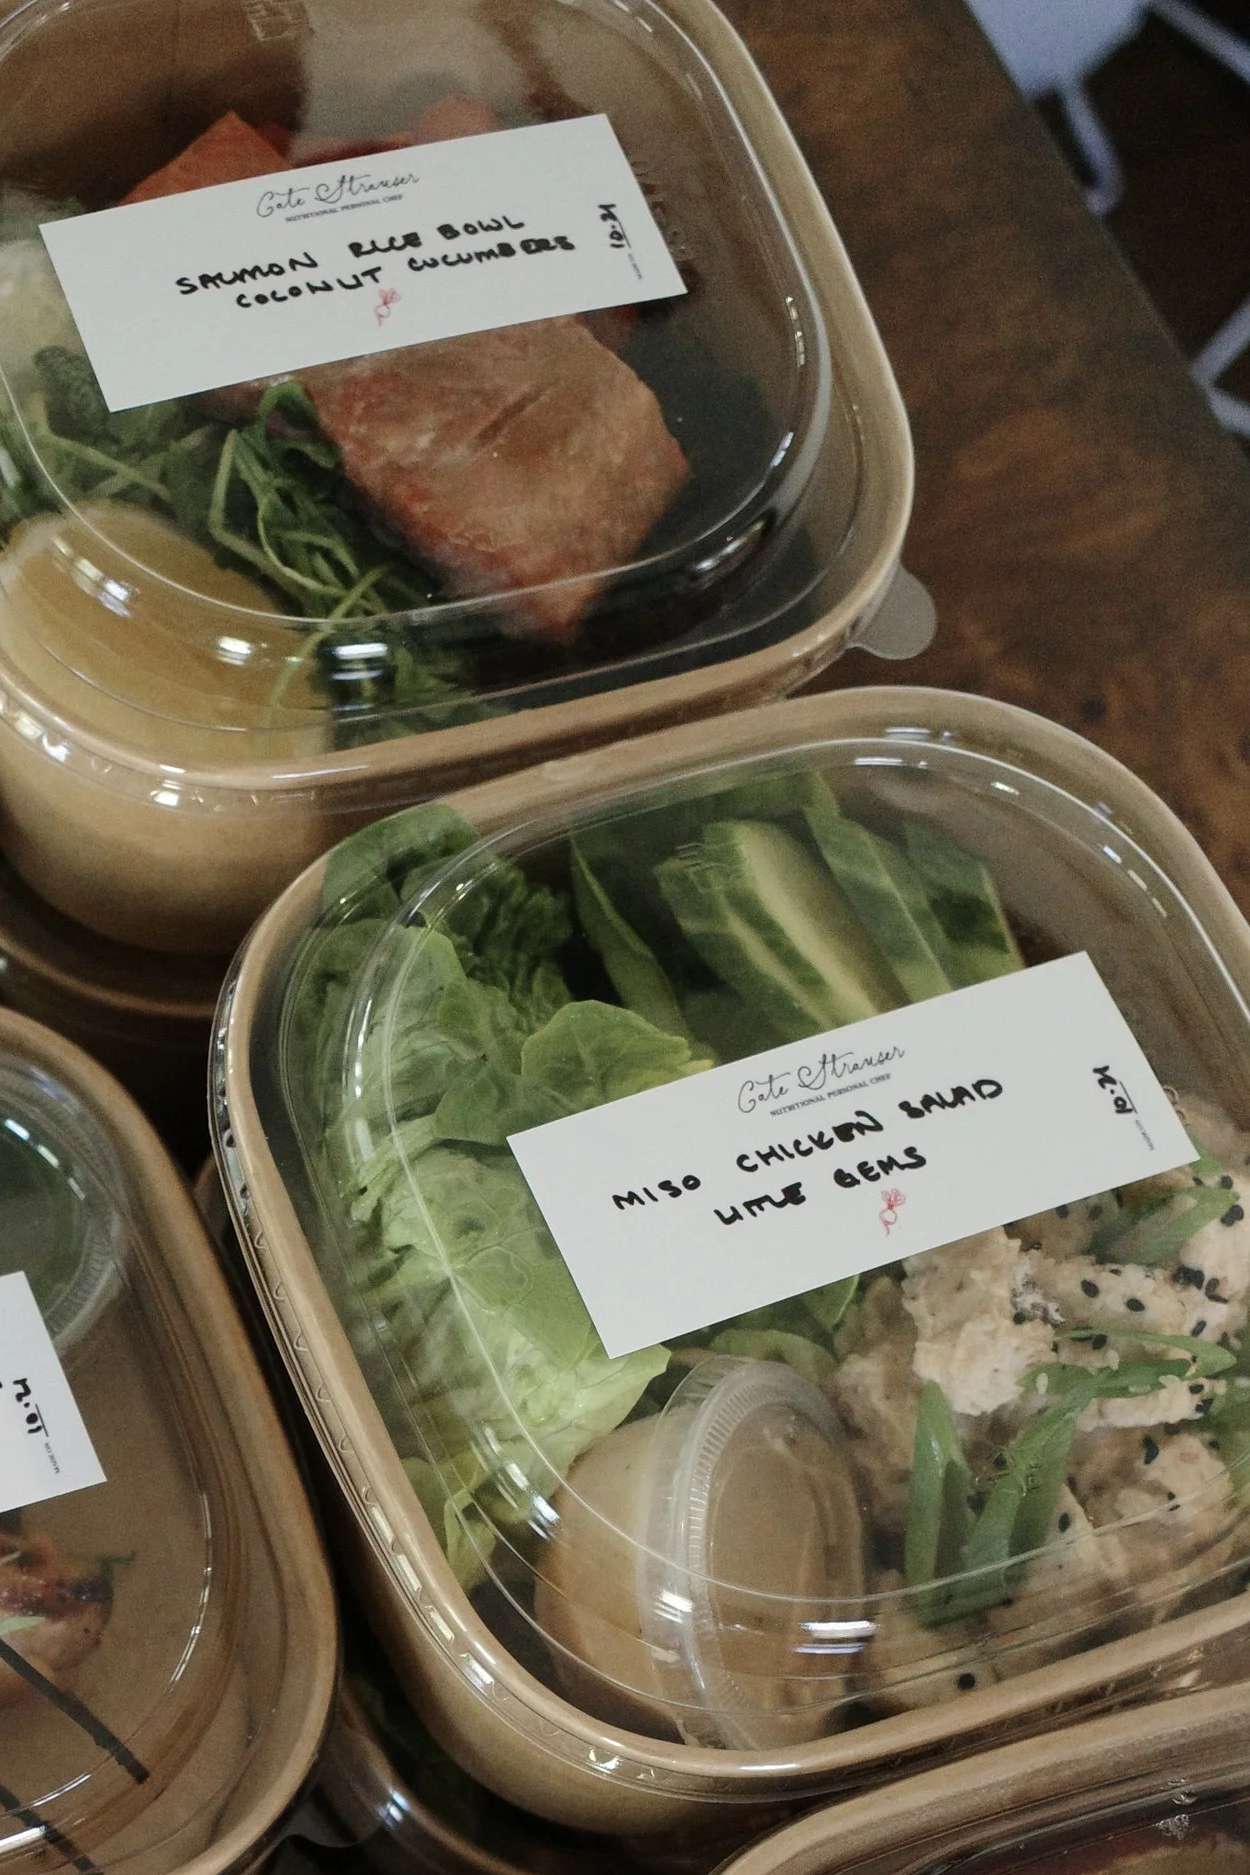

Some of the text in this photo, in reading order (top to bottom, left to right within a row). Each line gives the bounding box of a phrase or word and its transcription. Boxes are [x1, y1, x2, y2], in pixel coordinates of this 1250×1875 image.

[176, 214, 524, 296] SALMON RICE BOWL
[236, 236, 575, 309] COCONUT CUCUMBERS
[769, 1073, 892, 1118] NUTRITIONAL PERSONAL CHEF
[611, 1078, 1005, 1212] MISO CHICKEN SALAD
[833, 1145, 928, 1191] GEMS
